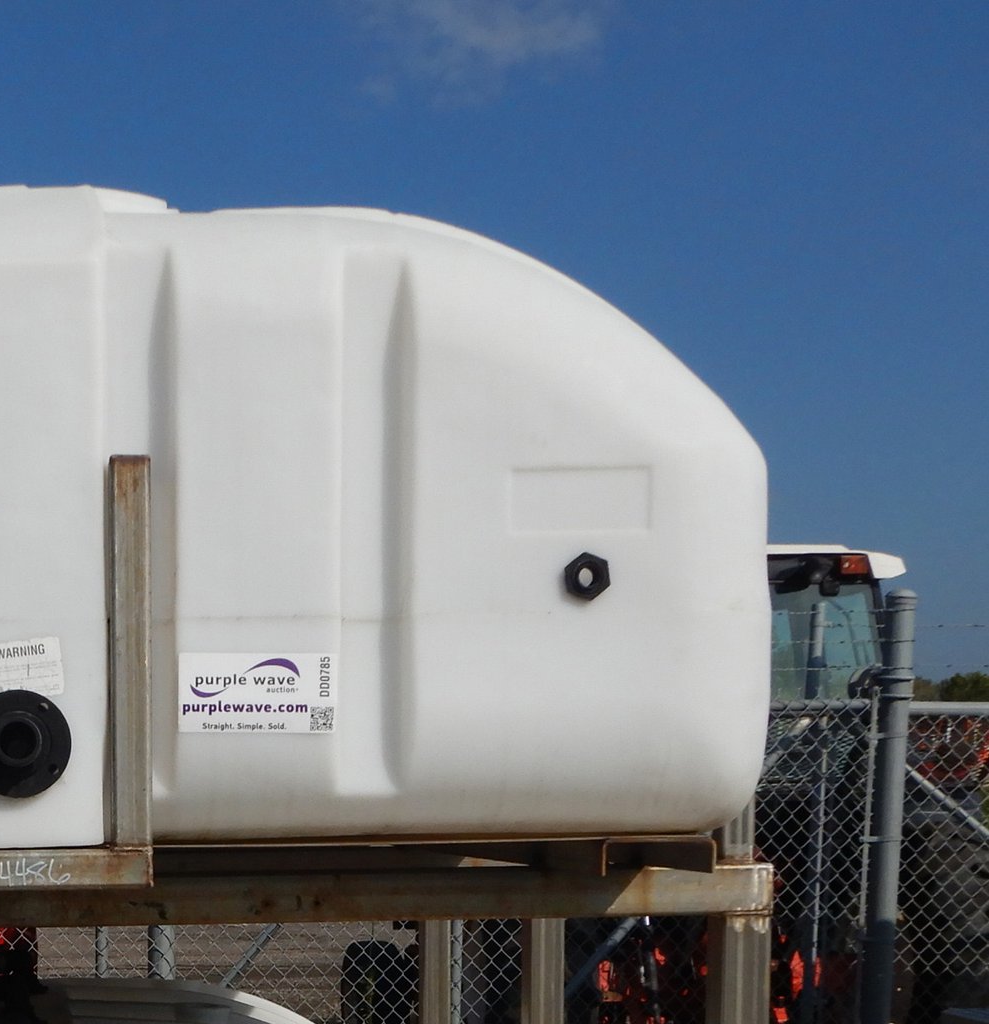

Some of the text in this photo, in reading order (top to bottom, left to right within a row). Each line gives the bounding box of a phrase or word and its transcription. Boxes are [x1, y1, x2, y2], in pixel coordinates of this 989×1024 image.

[195, 673, 296, 687] purple wave
[319, 656, 331, 697] DD0785
[182, 701, 308, 716] purplewave.com
[202, 722, 287, 731] Straight. Simple. Sold.
